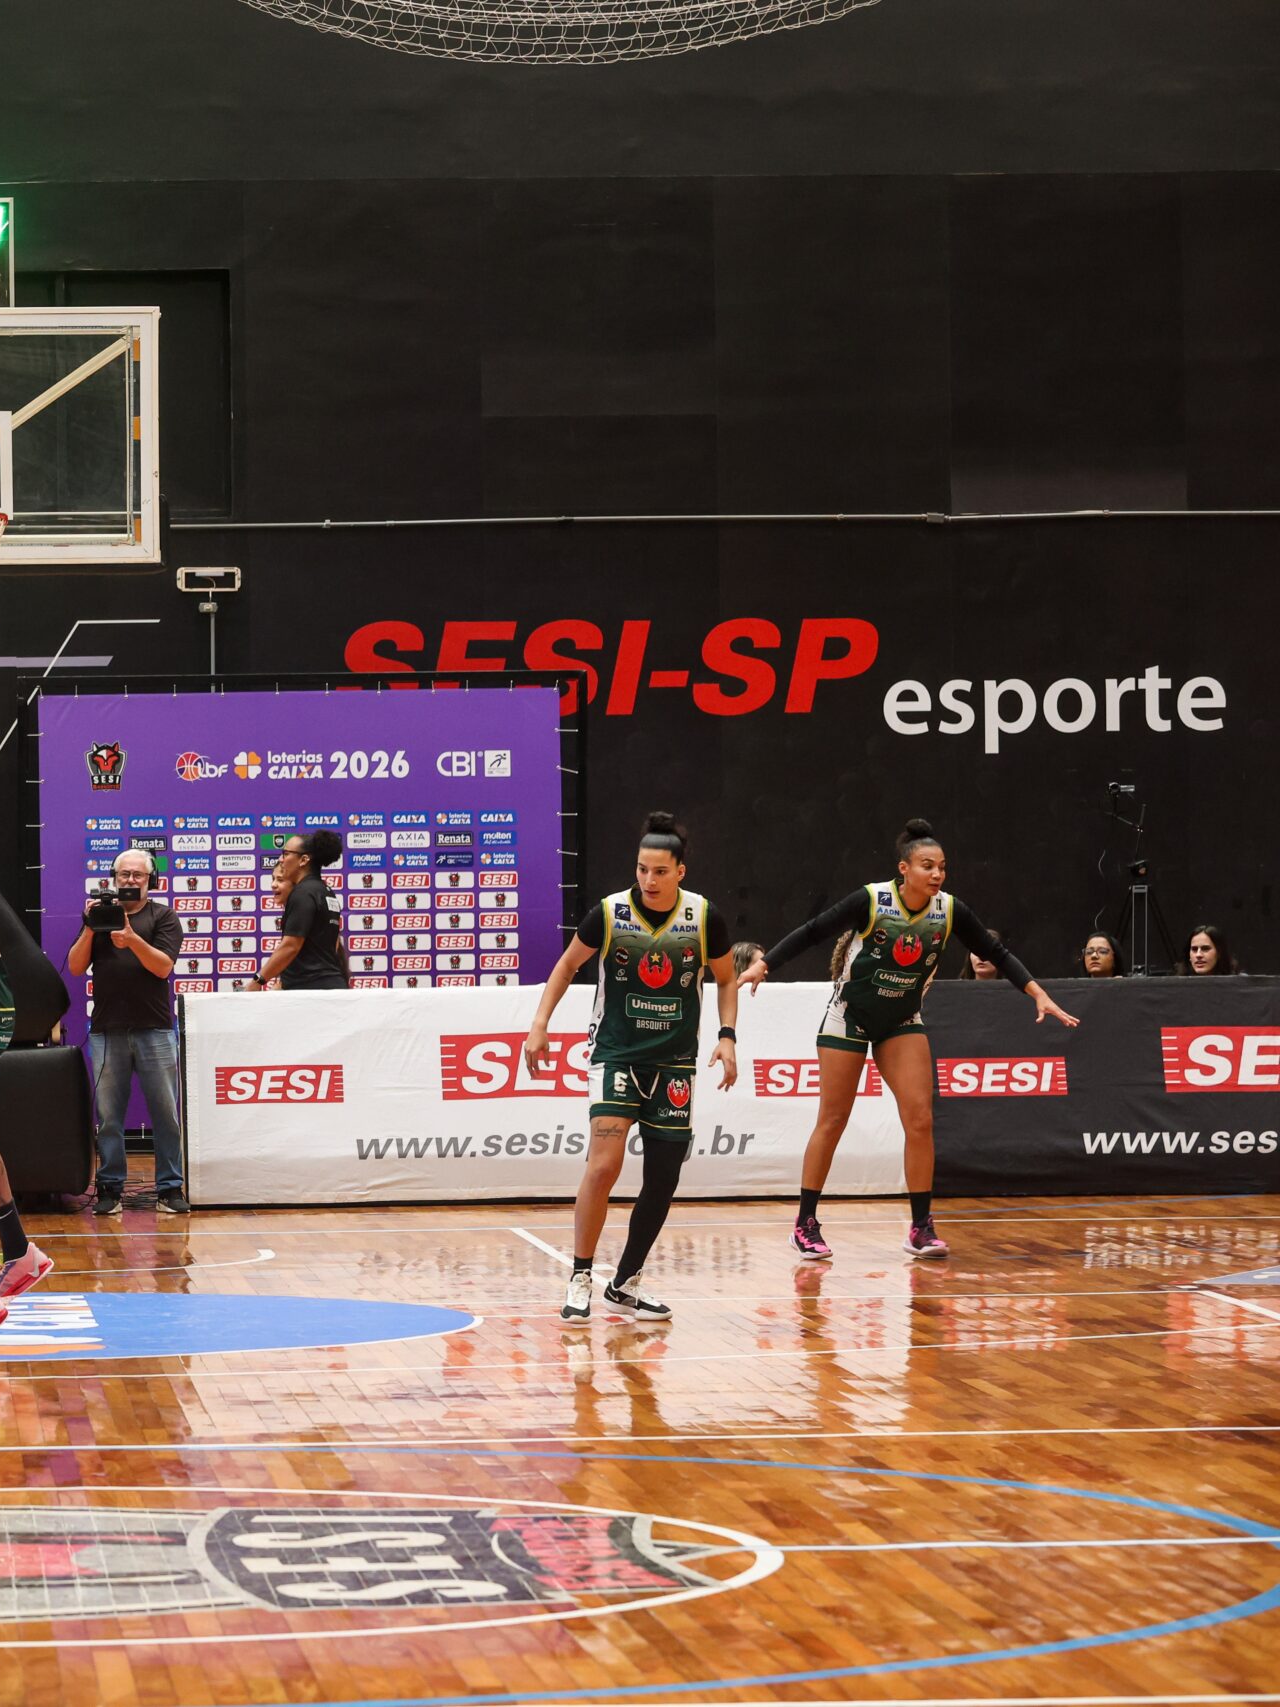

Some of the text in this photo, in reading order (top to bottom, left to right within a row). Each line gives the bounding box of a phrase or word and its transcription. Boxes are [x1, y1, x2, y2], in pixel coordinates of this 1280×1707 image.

[336, 618, 1227, 754] SESI-SP esporte
[267, 750, 323, 764] loterias
[329, 750, 410, 779] 2026
[268, 764, 323, 779] CAIXA
[93, 775, 120, 784] SESI
[218, 817, 251, 826] CAIXA
[306, 816, 339, 825] CAIXA
[393, 814, 426, 823] CAIXA
[481, 813, 514, 822] CAIXA
[131, 819, 164, 828] CAIXA
[178, 836, 206, 844] AXIA
[218, 836, 252, 845] rumo
[397, 833, 426, 841] AXIA
[437, 834, 471, 844] Renata
[483, 832, 512, 840] molten
[91, 838, 119, 846] molten
[131, 839, 165, 849] Renata
[222, 879, 252, 889] SESI
[396, 876, 426, 886] SESI
[483, 875, 513, 885] SESI
[178, 900, 208, 910] SESI
[352, 897, 383, 907] SESI
[440, 896, 470, 906] SESI
[684, 907, 694, 921] 6
[222, 920, 252, 930] SESI
[396, 917, 426, 927] SESI
[484, 916, 514, 926] SESI
[180, 941, 208, 951] SESI
[353, 938, 383, 948] SESI
[440, 937, 470, 947] SESI
[222, 961, 252, 971] SESI
[397, 958, 427, 968] SESI
[484, 957, 514, 967] SESI
[441, 978, 471, 987] SESI
[879, 973, 917, 984] Unimed
[179, 982, 209, 992] SESI
[353, 980, 384, 989] SESI
[632, 999, 677, 1012] Unimed
[636, 1019, 670, 1031] BASQUETE
[766, 1063, 870, 1094] SEI
[950, 1061, 1054, 1094] SESI
[227, 1069, 332, 1102] SESI
[669, 1109, 689, 1118] MRV
